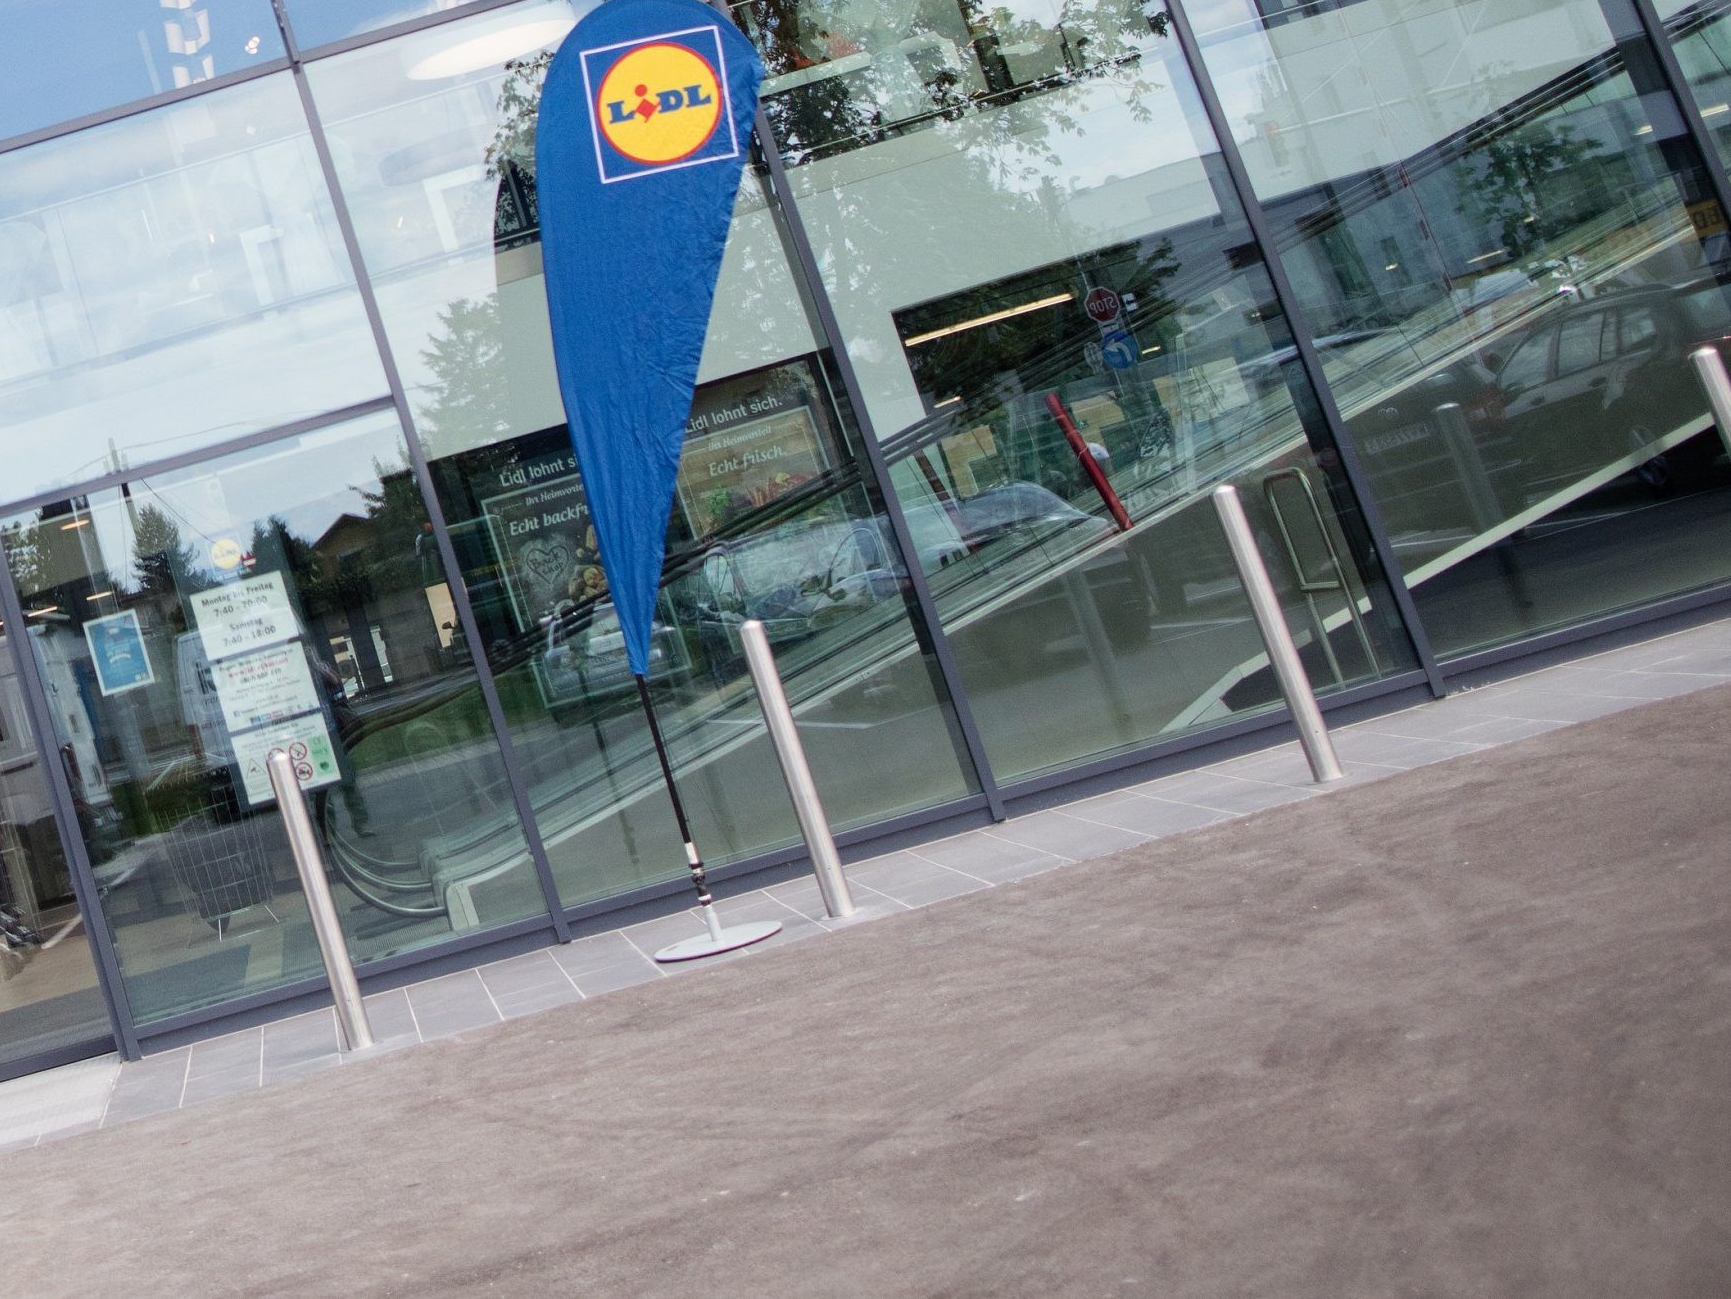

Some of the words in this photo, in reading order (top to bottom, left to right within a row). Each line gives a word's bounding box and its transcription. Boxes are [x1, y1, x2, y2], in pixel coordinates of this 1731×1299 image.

[711, 404, 748, 425] lohnt
[750, 396, 783, 414] sich.
[499, 468, 527, 487] Lidl
[529, 458, 565, 479] lohnt
[708, 457, 739, 477] Echt
[509, 517, 540, 536] Echt
[201, 594, 231, 608] Montag
[246, 582, 274, 595] Freitag
[230, 617, 263, 632] Samstag
